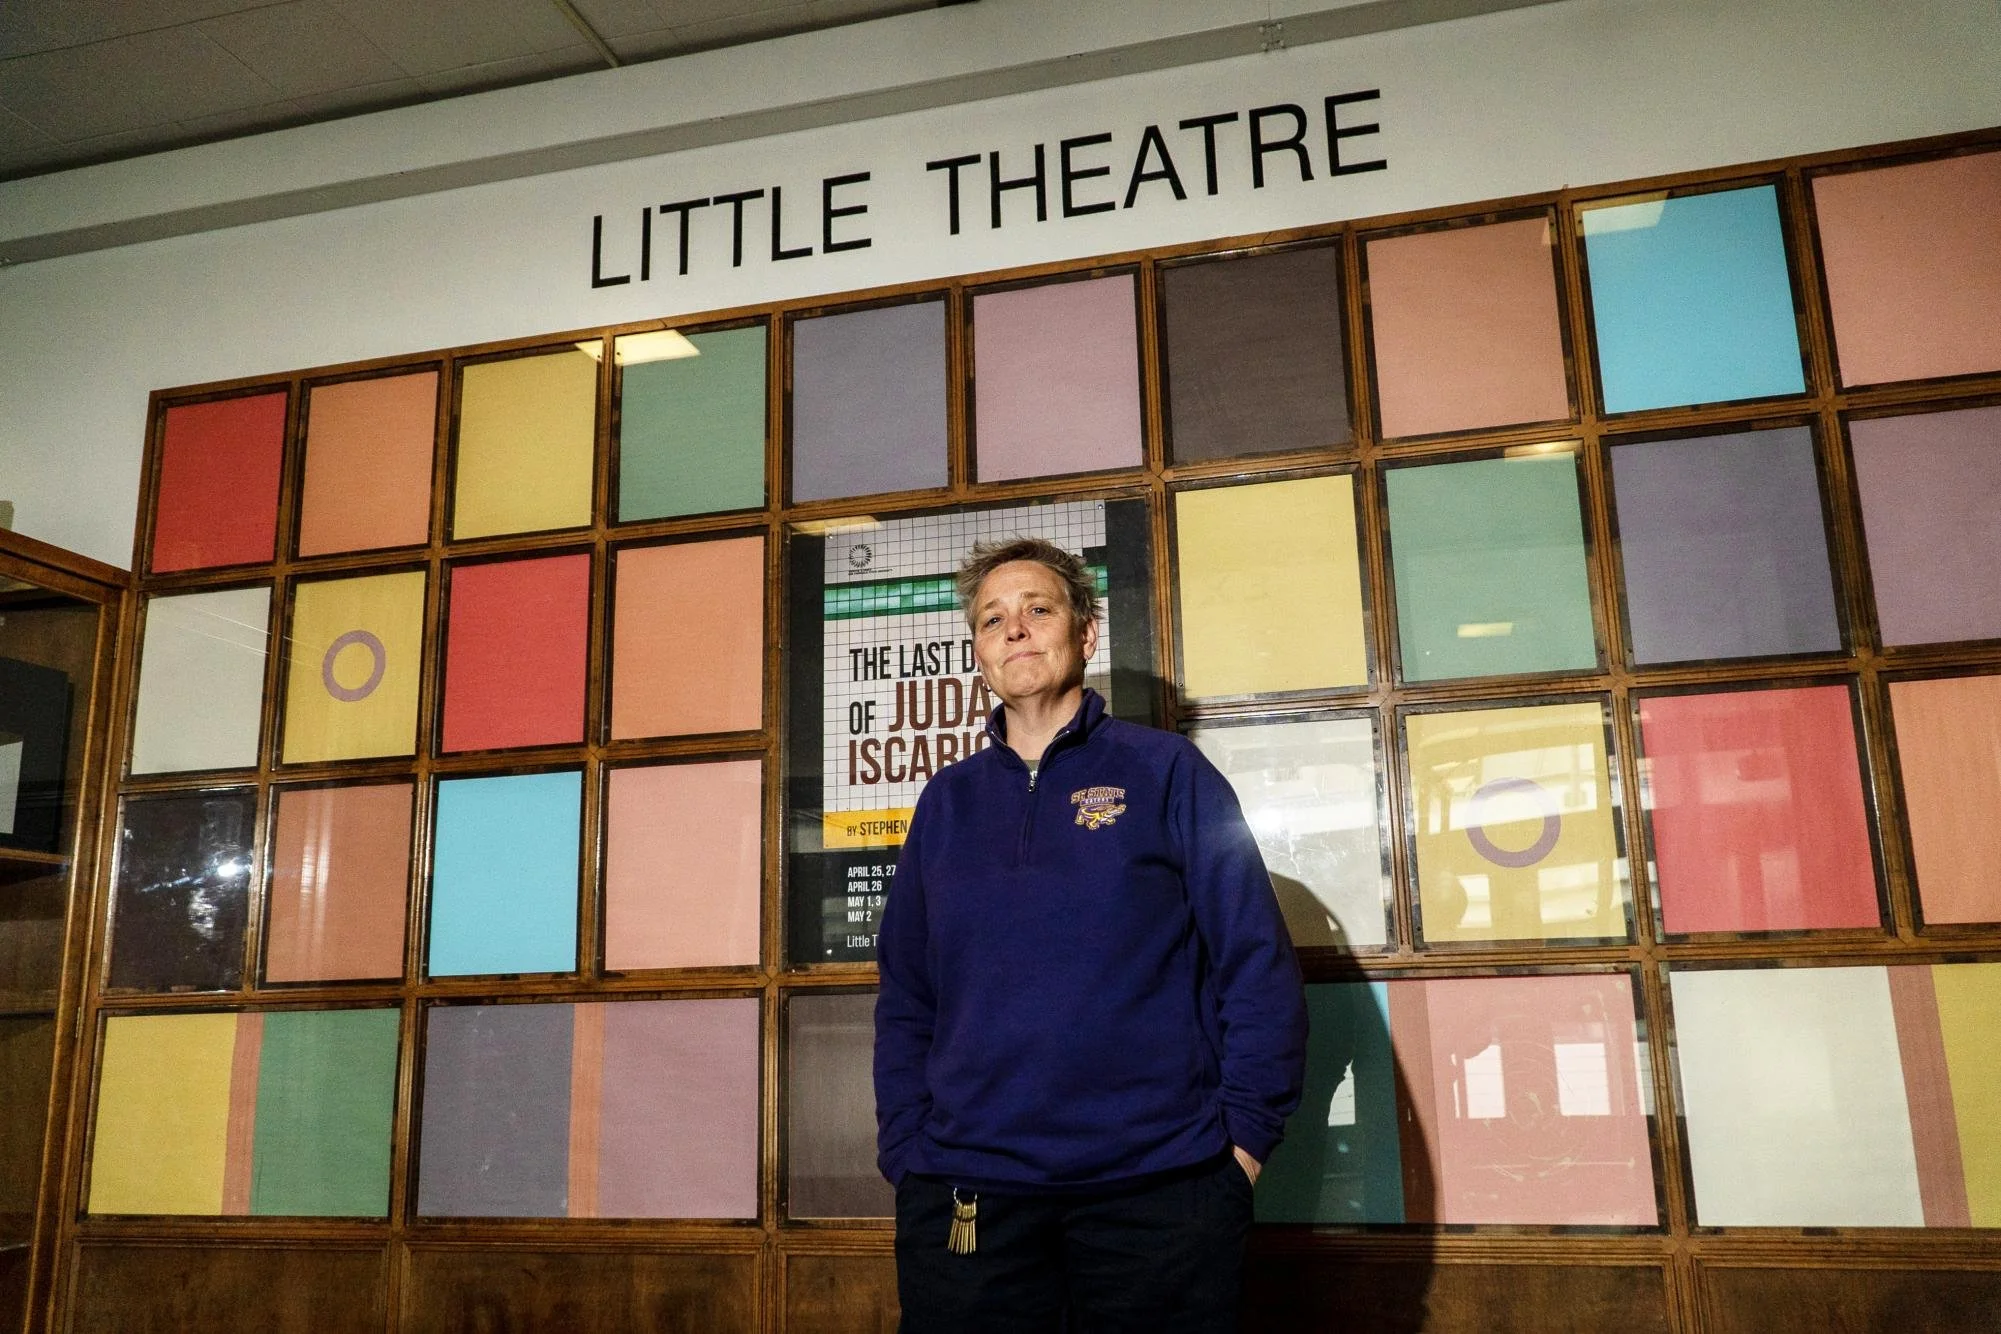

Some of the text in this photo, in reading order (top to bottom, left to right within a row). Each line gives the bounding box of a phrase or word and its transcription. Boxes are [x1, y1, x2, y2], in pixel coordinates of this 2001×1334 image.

[592, 88, 1388, 289] LITTLE THEATRE
[849, 639, 982, 681] THE LAST D
[849, 700, 876, 735] OF
[1071, 786, 1126, 804] SF STATE
[847, 819, 908, 836] BY STEPHEN
[847, 864, 897, 878] APRIL 25, 27
[847, 880, 883, 893] APRIL 26
[847, 895, 881, 908] MAY 1, 3
[847, 910, 872, 923] MAY 2
[847, 934, 870, 948] Little
